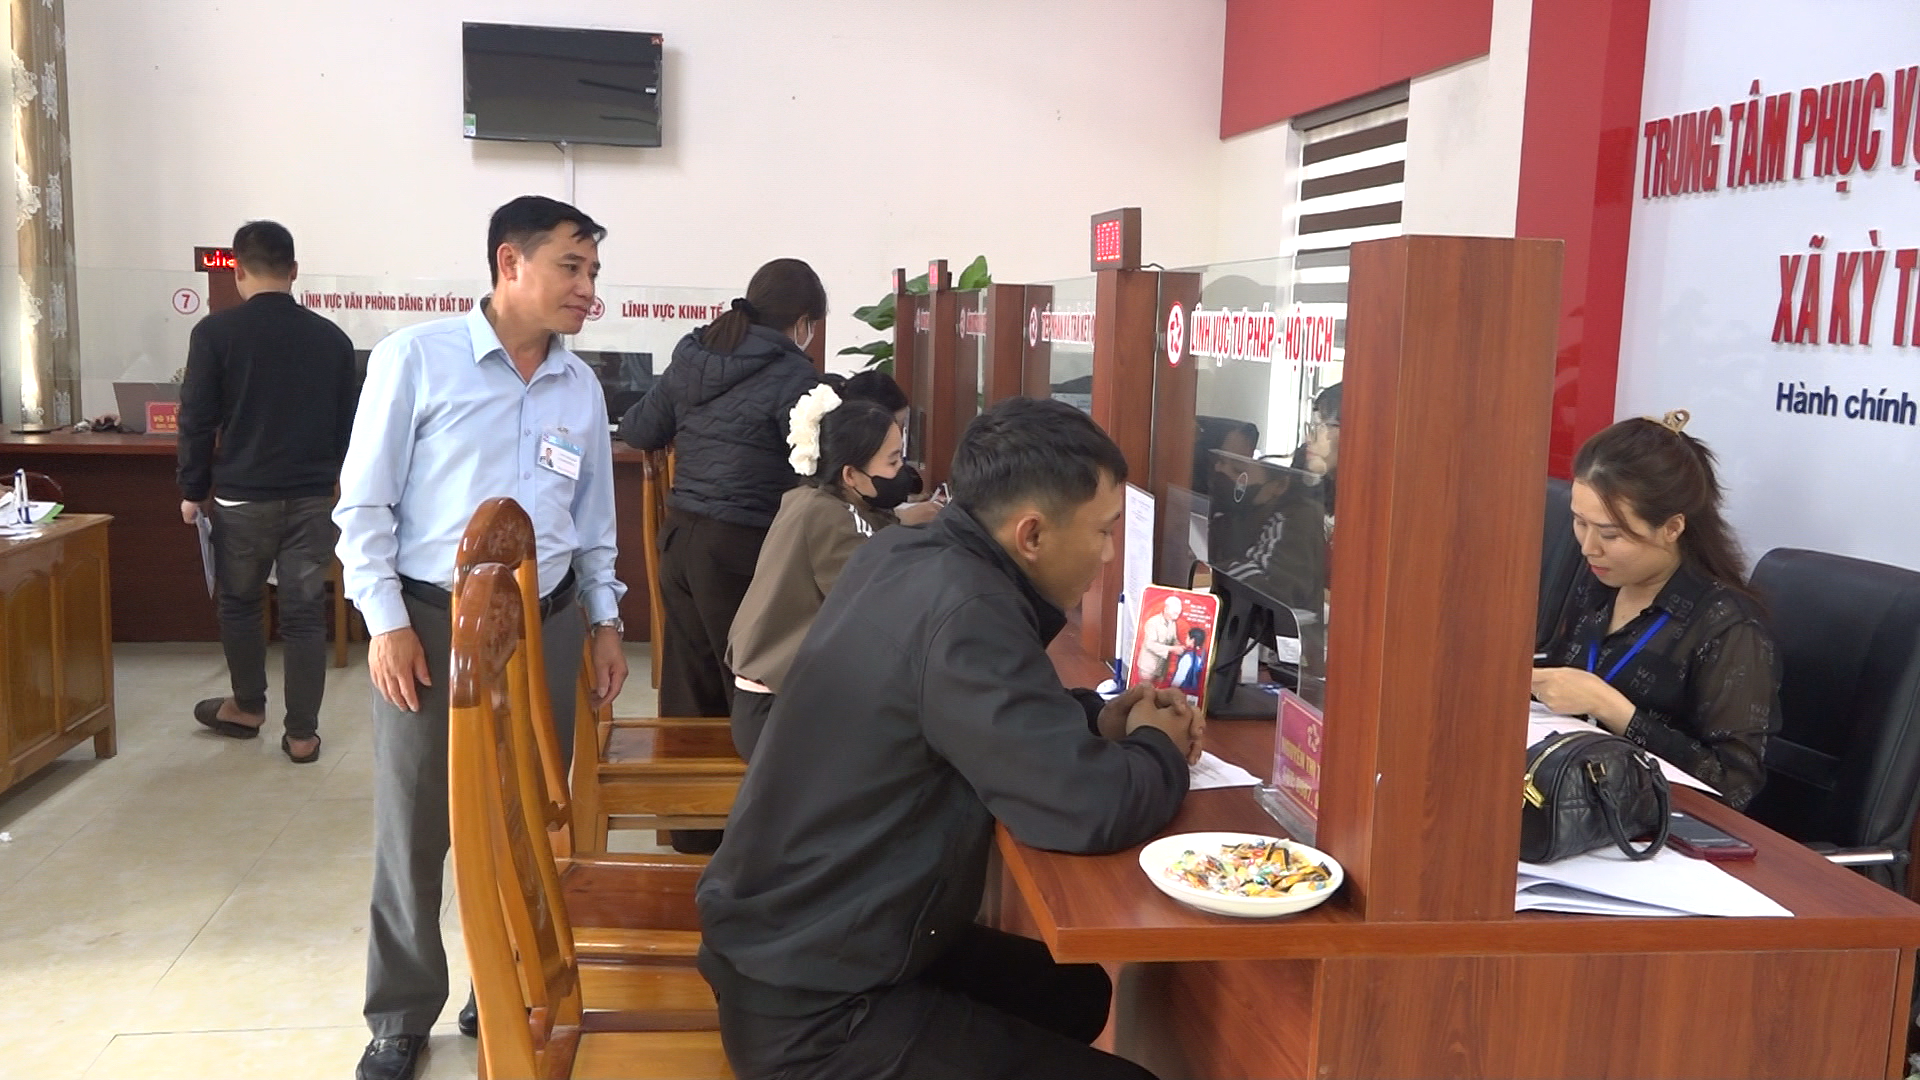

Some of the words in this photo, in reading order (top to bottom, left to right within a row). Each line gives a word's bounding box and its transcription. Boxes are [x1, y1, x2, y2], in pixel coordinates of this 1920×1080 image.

[1643, 106, 1723, 199] TRUNG
[1726, 79, 1793, 188] TÂM
[1793, 72, 1886, 193] PHỤC
[1891, 66, 1920, 182] V
[323, 292, 342, 312] VỰC
[344, 291, 362, 309] VĂN
[365, 291, 395, 311] PHÒNG
[398, 292, 423, 312] ĐĂNG
[425, 293, 437, 312] KÝ
[439, 291, 456, 312] ĐẤT
[622, 300, 648, 317] LĨNH
[652, 304, 675, 322] VỰC
[678, 305, 706, 319] KINH
[1771, 234, 1825, 344] XÃ
[1828, 229, 1886, 345] KỲ
[1893, 248, 1920, 347] T
[1191, 304, 1211, 353] LĨNH
[1211, 308, 1231, 364] VỰC
[1232, 308, 1246, 357] TƯ
[1247, 304, 1275, 359] PHÁP
[1285, 305, 1301, 372] HỘ
[1304, 315, 1334, 374] TỊCH
[1776, 381, 1839, 417] Hành
[1844, 387, 1918, 426] chính
